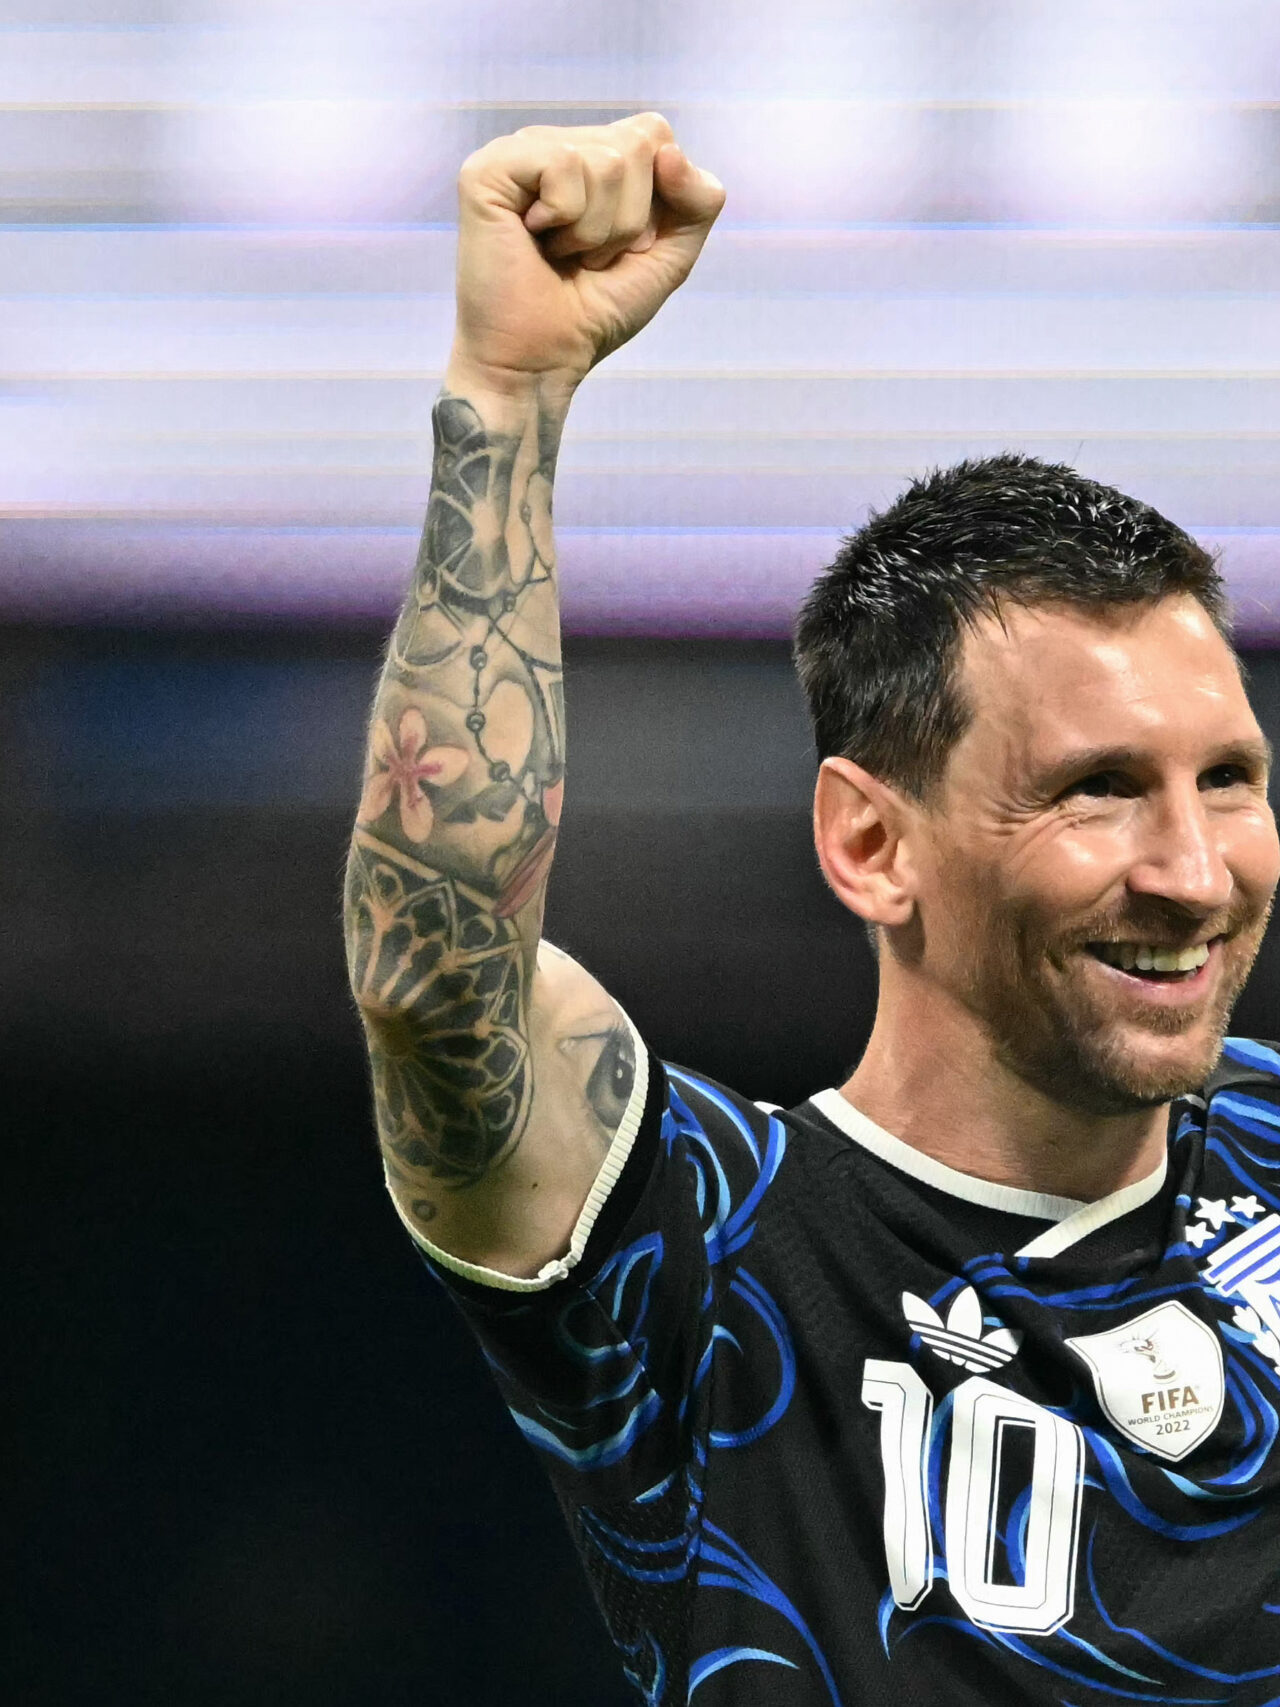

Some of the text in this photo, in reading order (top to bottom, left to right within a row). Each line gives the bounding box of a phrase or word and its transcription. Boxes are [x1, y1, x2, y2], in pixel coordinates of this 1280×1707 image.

[1141, 1386, 1199, 1414] FIFA
[1128, 1406, 1214, 1426] WORLD CHAMPIONS
[1156, 1420, 1191, 1436] 2022
[861, 1358, 1086, 1637] 10
